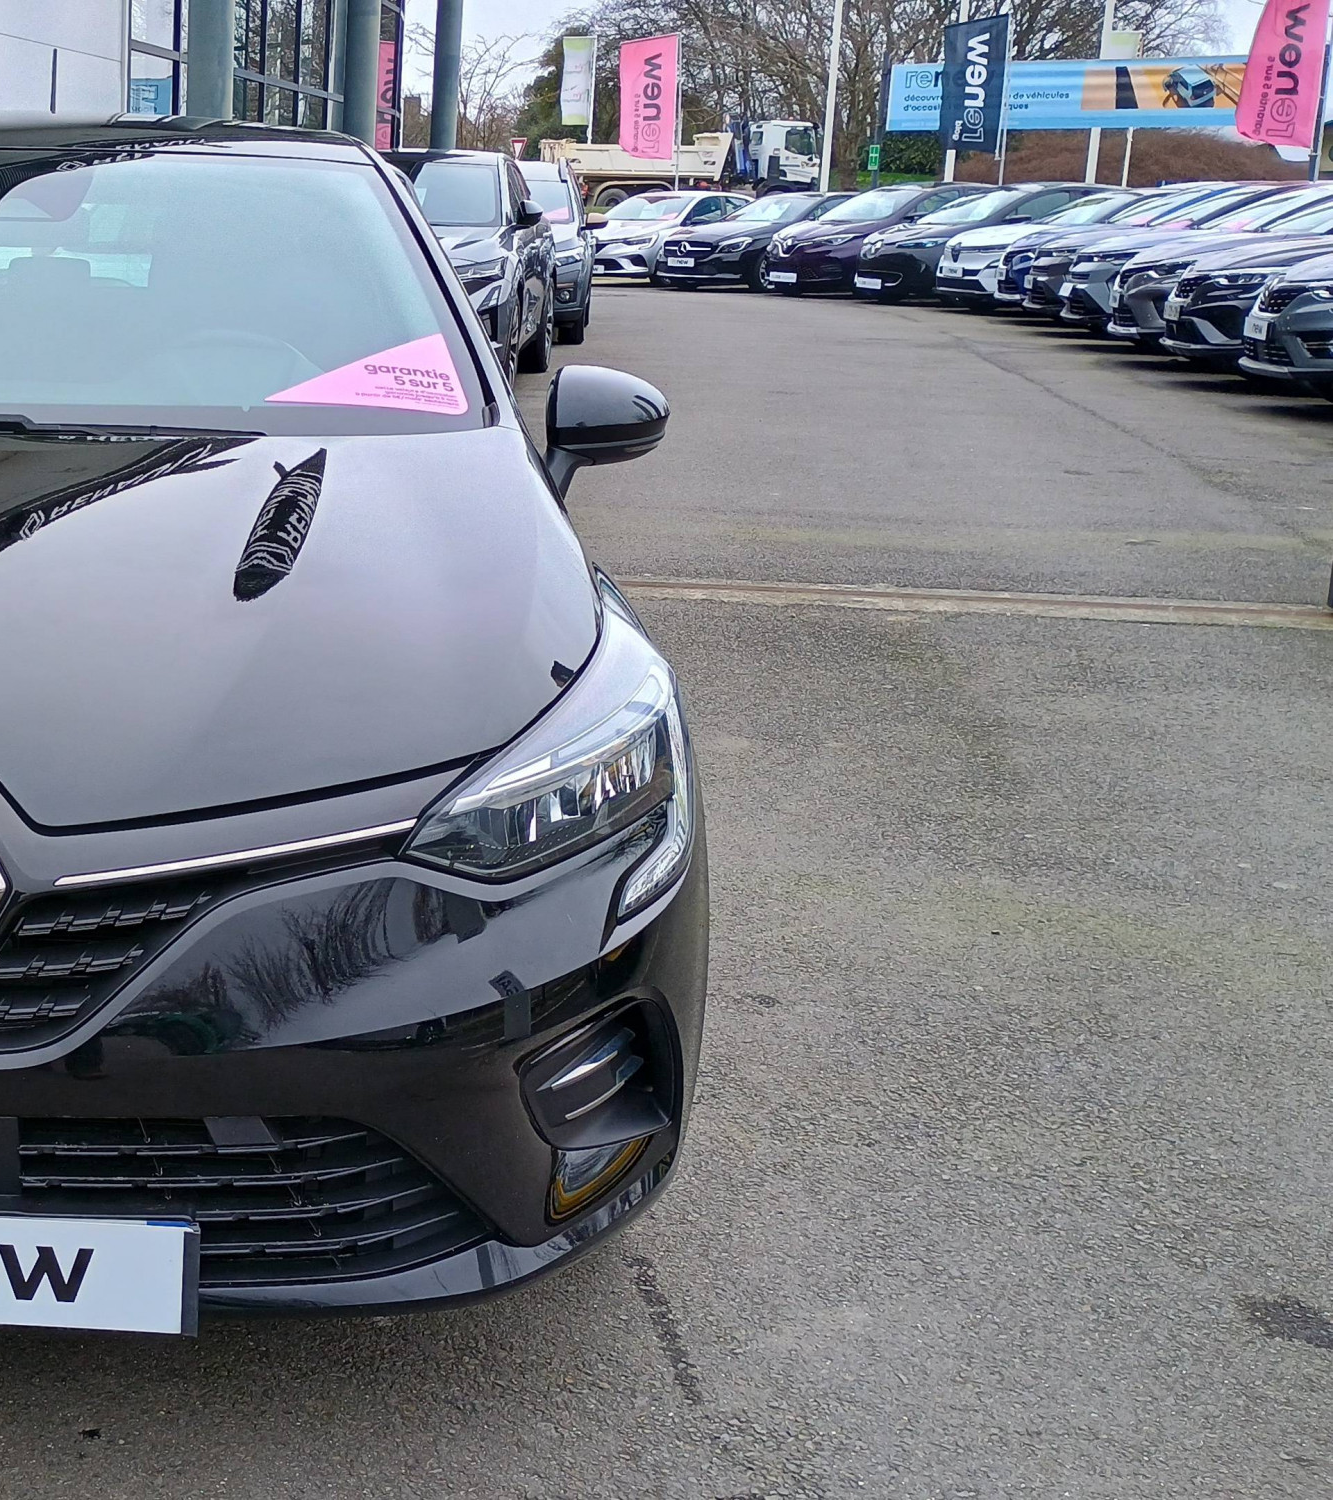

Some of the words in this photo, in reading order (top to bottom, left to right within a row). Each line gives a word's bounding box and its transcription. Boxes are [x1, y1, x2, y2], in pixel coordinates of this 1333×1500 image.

[904, 94, 942, 102] découvr
[364, 364, 450, 381] garantie
[394, 375, 406, 386] 5
[408, 379, 439, 390] sur
[442, 382, 454, 392] 5
